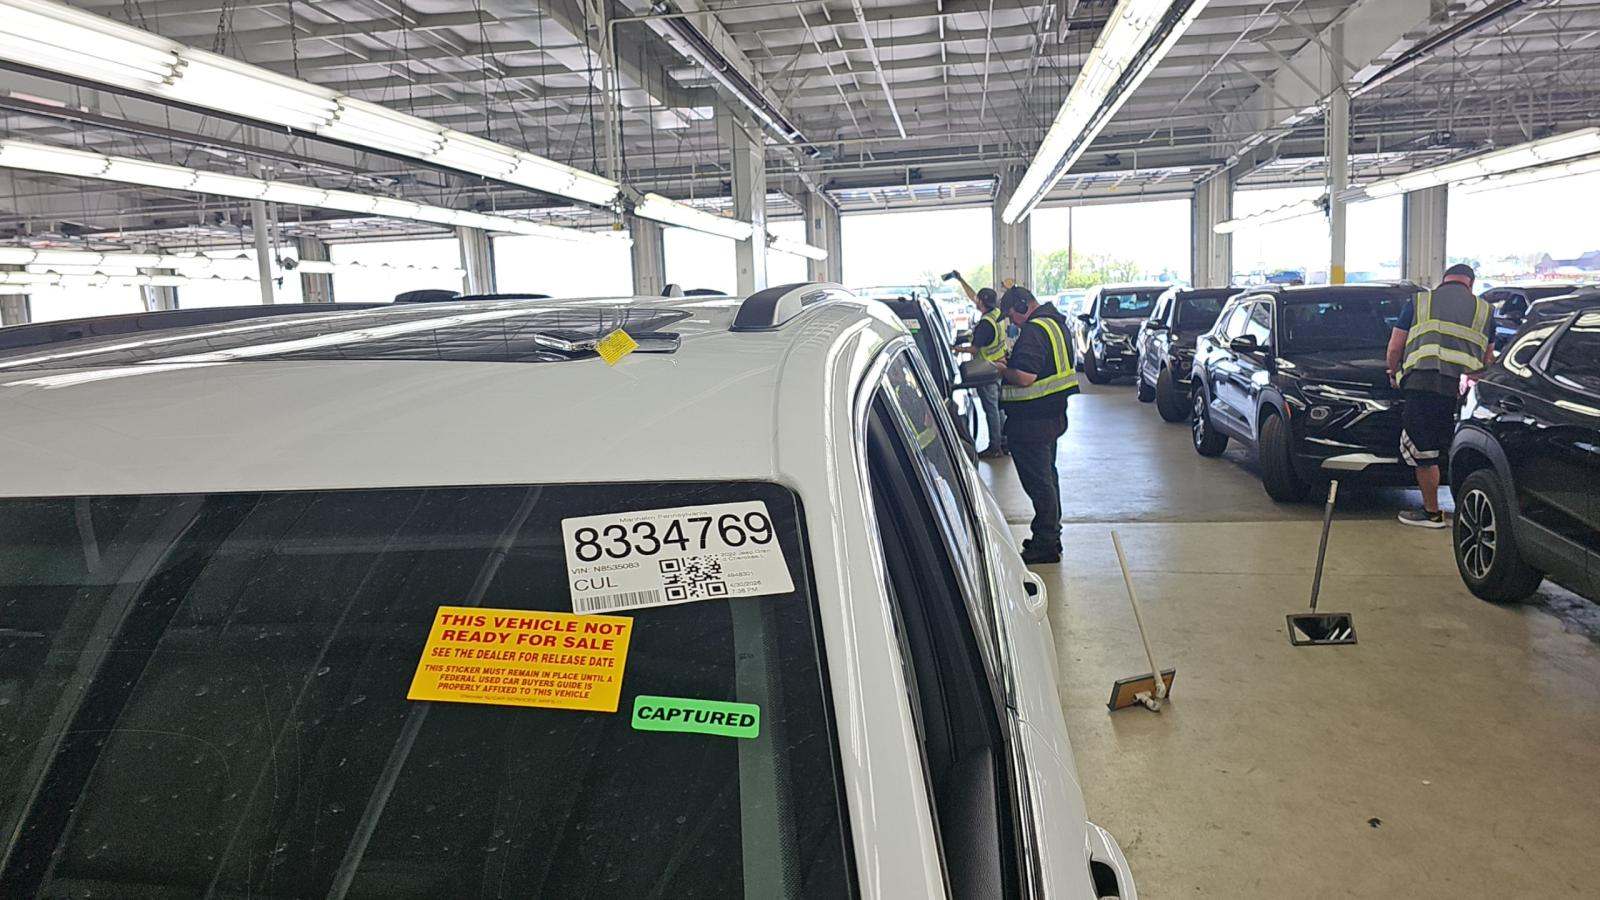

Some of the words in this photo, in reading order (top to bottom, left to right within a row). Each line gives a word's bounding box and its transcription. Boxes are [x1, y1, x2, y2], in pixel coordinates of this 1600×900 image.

[575, 511, 773, 562] 8334769
[574, 576, 618, 591] CUL
[441, 614, 487, 627] THIS
[493, 617, 578, 632] VEHICLE
[584, 622, 626, 636] NOT
[441, 629, 511, 644] READY
[516, 633, 557, 647] FOR
[563, 636, 614, 651] SALE
[431, 647, 452, 657] SEE
[454, 648, 475, 658] THE
[476, 649, 516, 661] DEALER
[518, 652, 539, 662] FOR
[541, 653, 588, 666] RELEASE
[588, 656, 615, 668] DATE
[425, 664, 444, 672] THIS
[446, 665, 481, 674] STICKER
[483, 667, 506, 675] MUST
[507, 668, 540, 678] REMAIN
[552, 672, 580, 680] PLACE
[581, 674, 604, 682] UNTIL
[439, 674, 476, 683] FEDERAL
[479, 676, 501, 684] USED
[502, 677, 520, 685] CAR
[521, 679, 554, 688] BUYERS
[556, 681, 584, 689] GUIDE
[437, 682, 481, 692] PROPERLY
[482, 685, 517, 694] AFFIXED
[520, 687, 531, 695] TO
[533, 688, 552, 696] THIS
[554, 690, 590, 699] VEHICLE
[637, 706, 756, 728] CAPTURED
